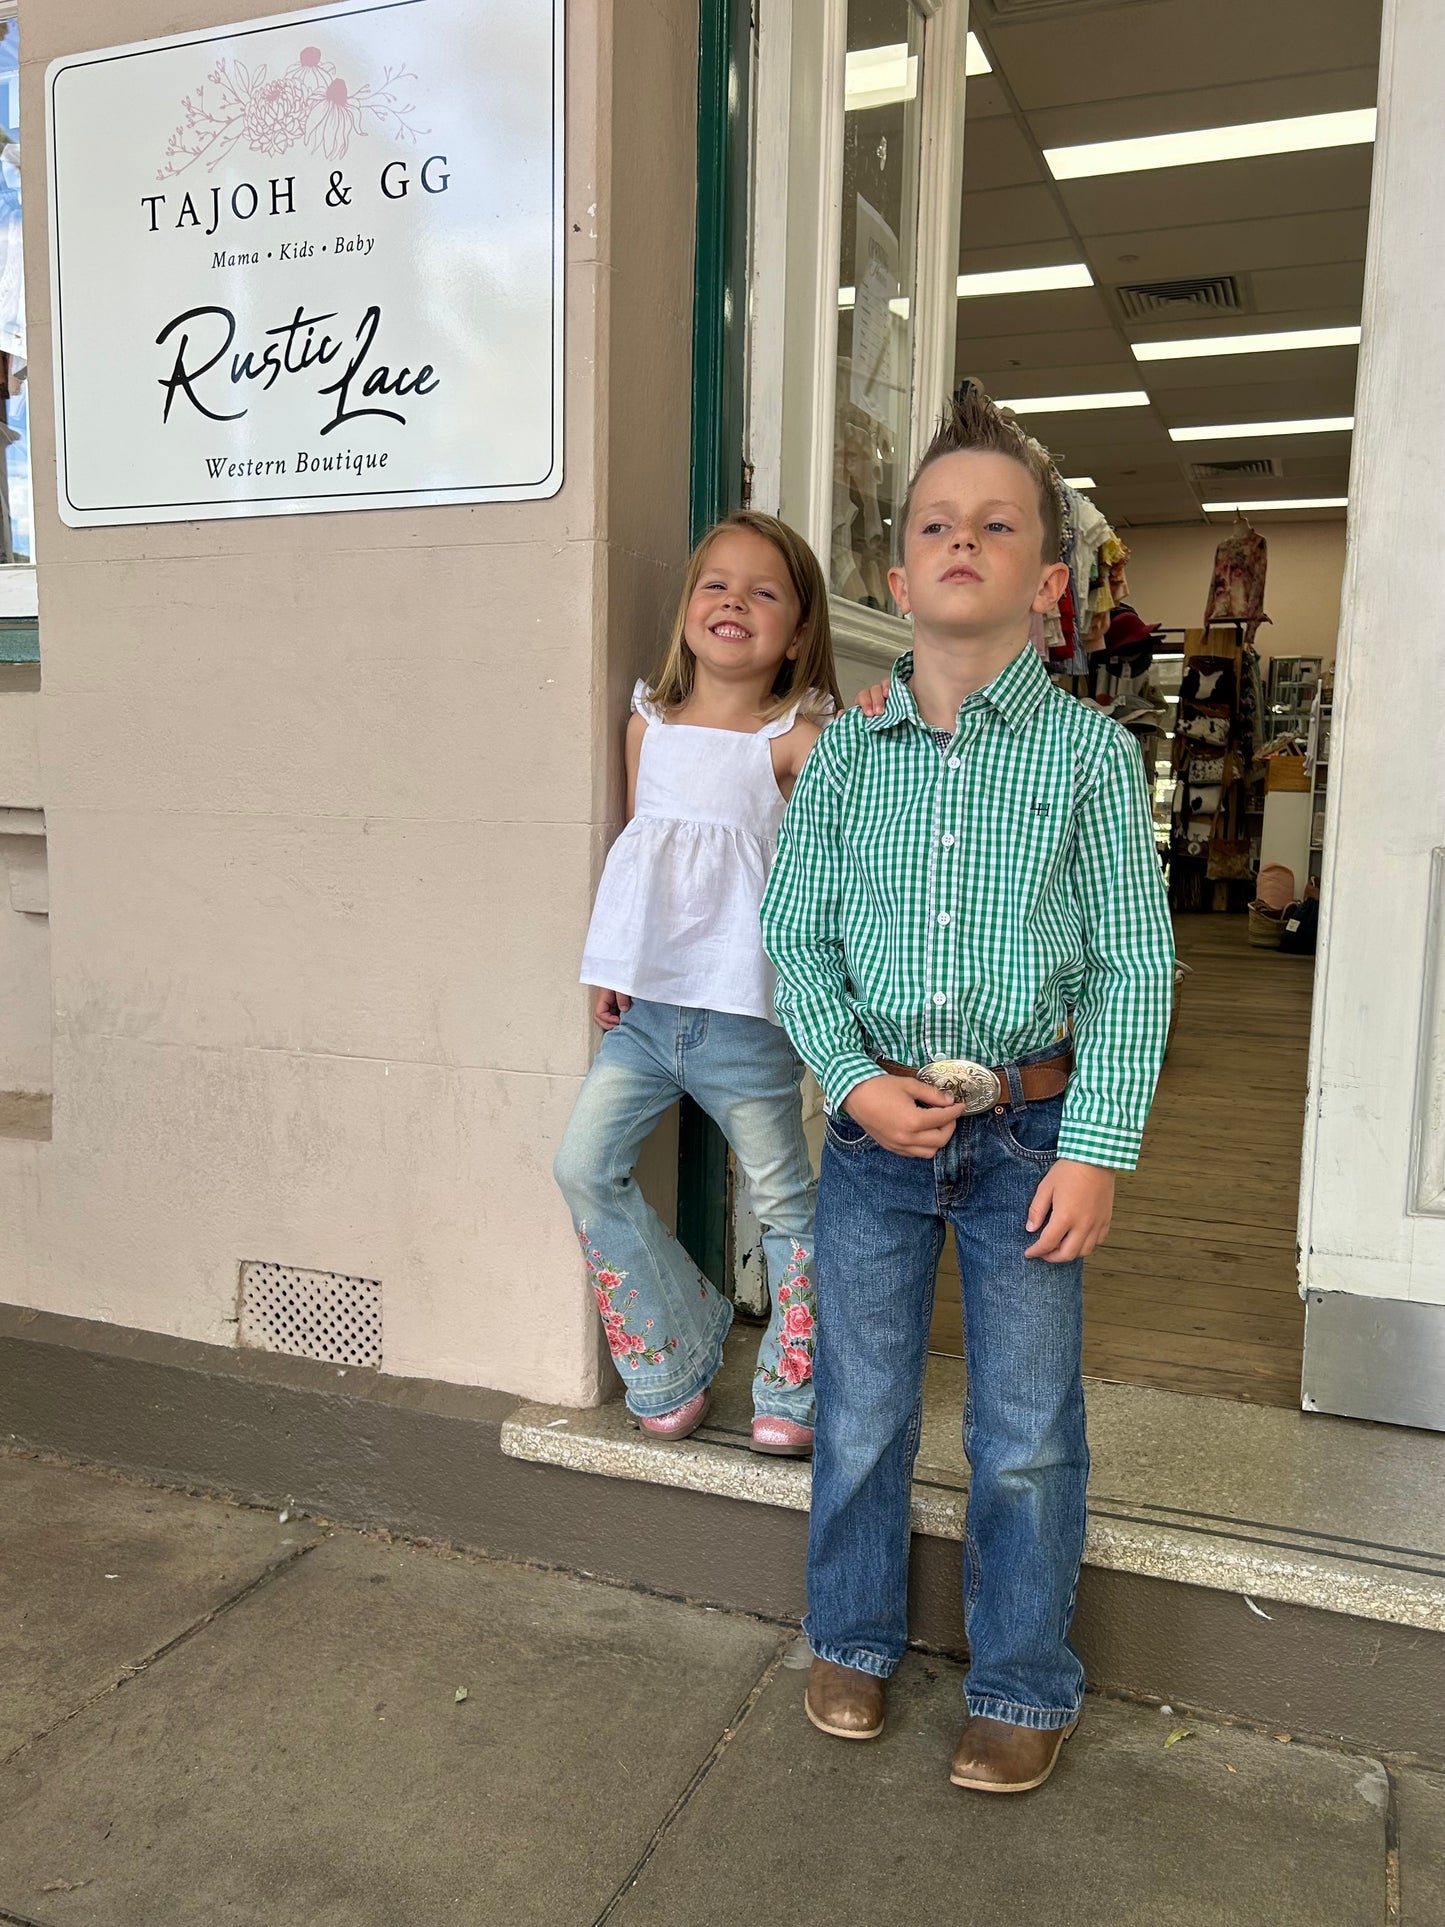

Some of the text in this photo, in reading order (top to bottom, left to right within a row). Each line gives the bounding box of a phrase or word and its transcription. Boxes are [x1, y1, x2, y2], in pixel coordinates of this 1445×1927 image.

[140, 155, 451, 236] TAJOH & GG
[211, 234, 375, 269] Mama Kids Baby
[155, 305, 441, 436] Rustic Lace
[205, 451, 388, 479] Western Boutique
